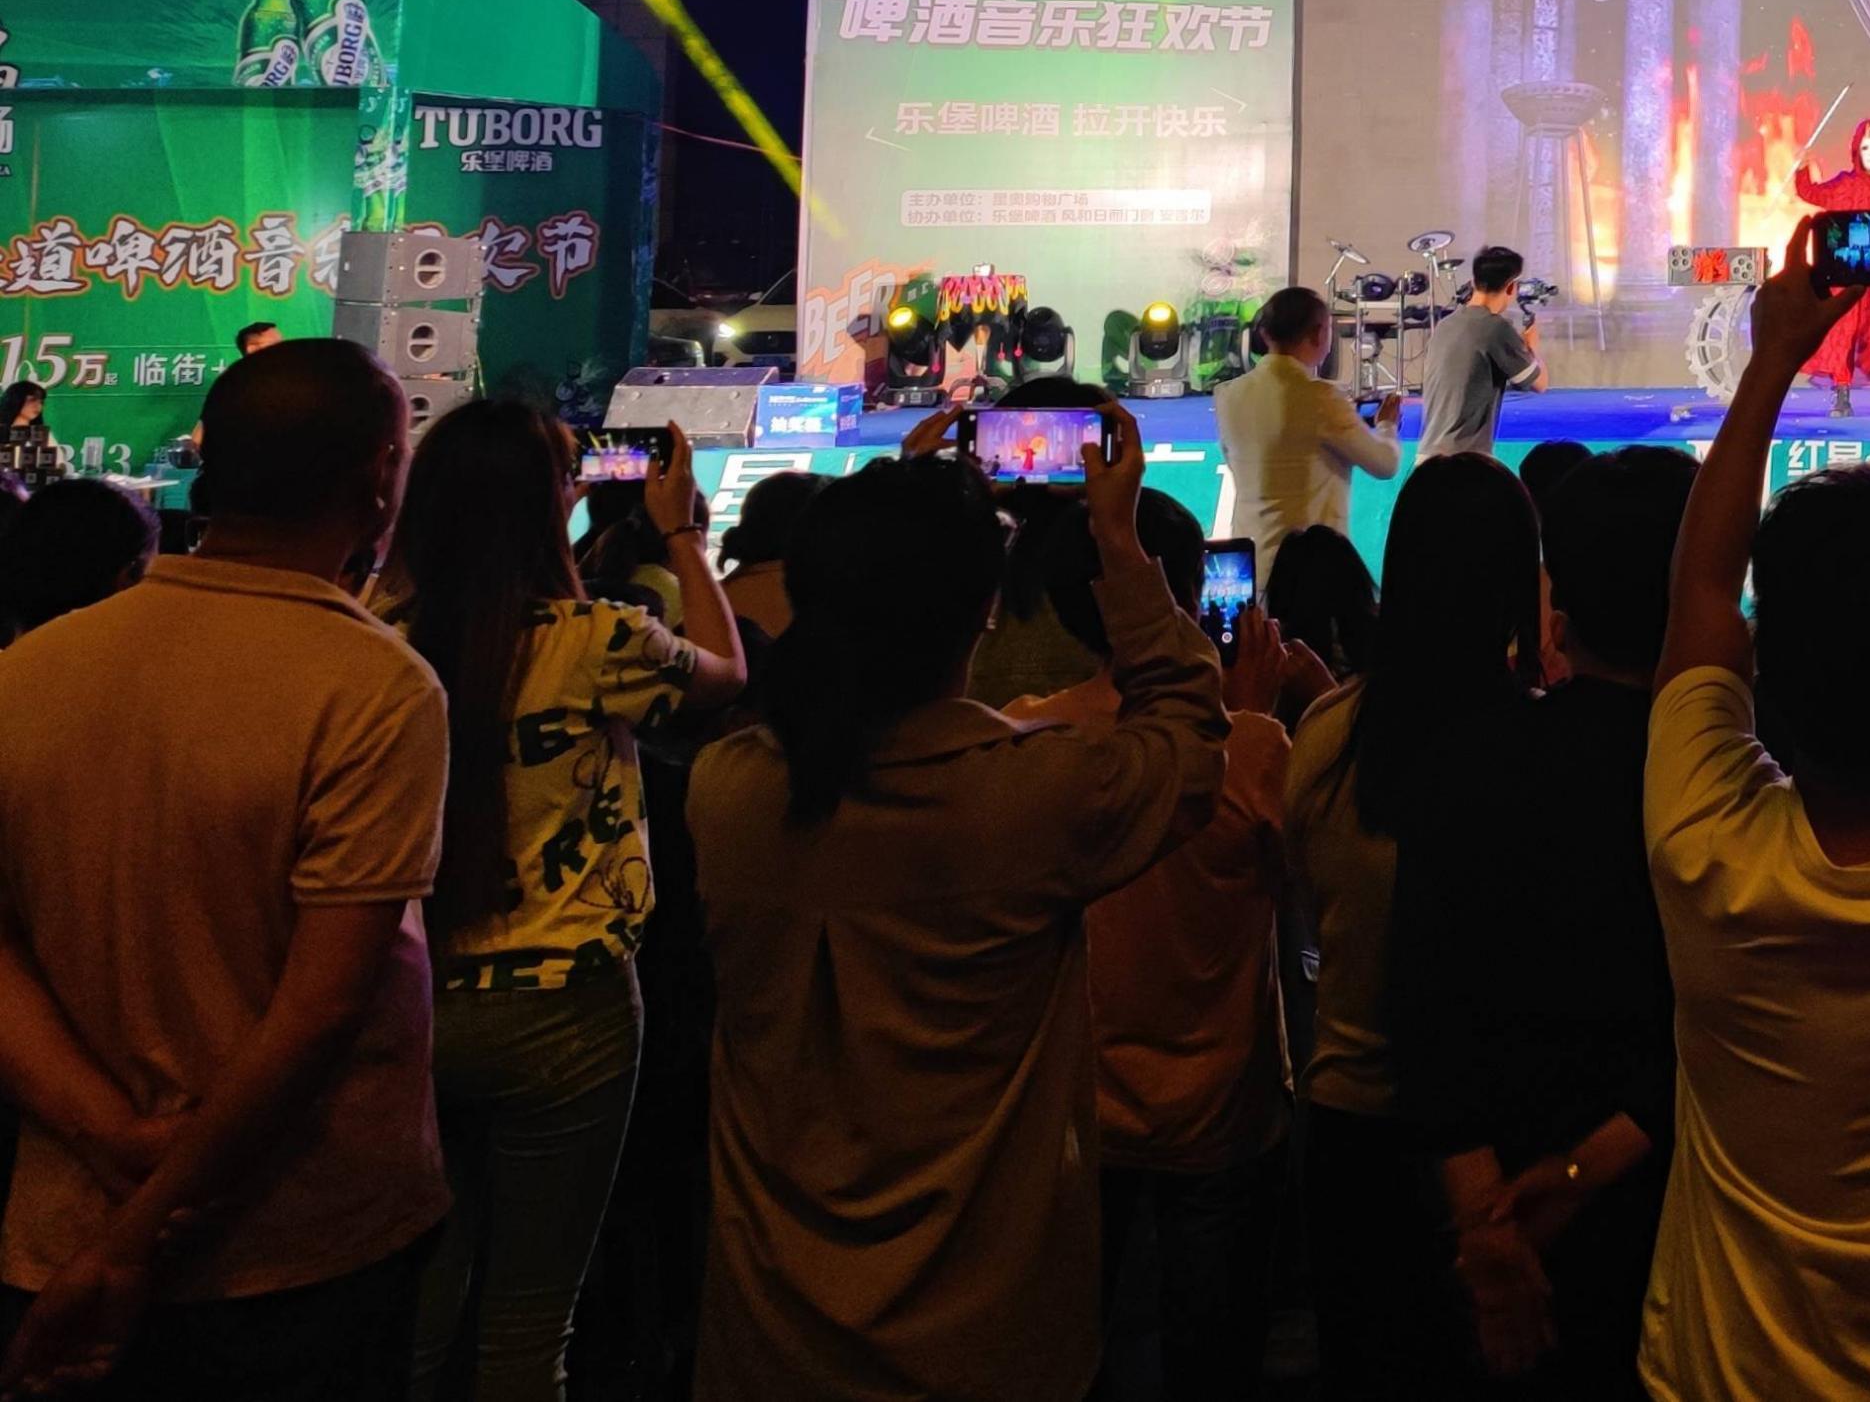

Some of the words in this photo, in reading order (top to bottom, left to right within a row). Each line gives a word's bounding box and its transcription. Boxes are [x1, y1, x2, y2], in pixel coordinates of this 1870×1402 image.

[414, 105, 603, 149] TUBORG
[894, 101, 1060, 136] 乐堡啤酒
[1072, 103, 1227, 137] 拉开快乐
[460, 150, 552, 172] 乐堡啤酒
